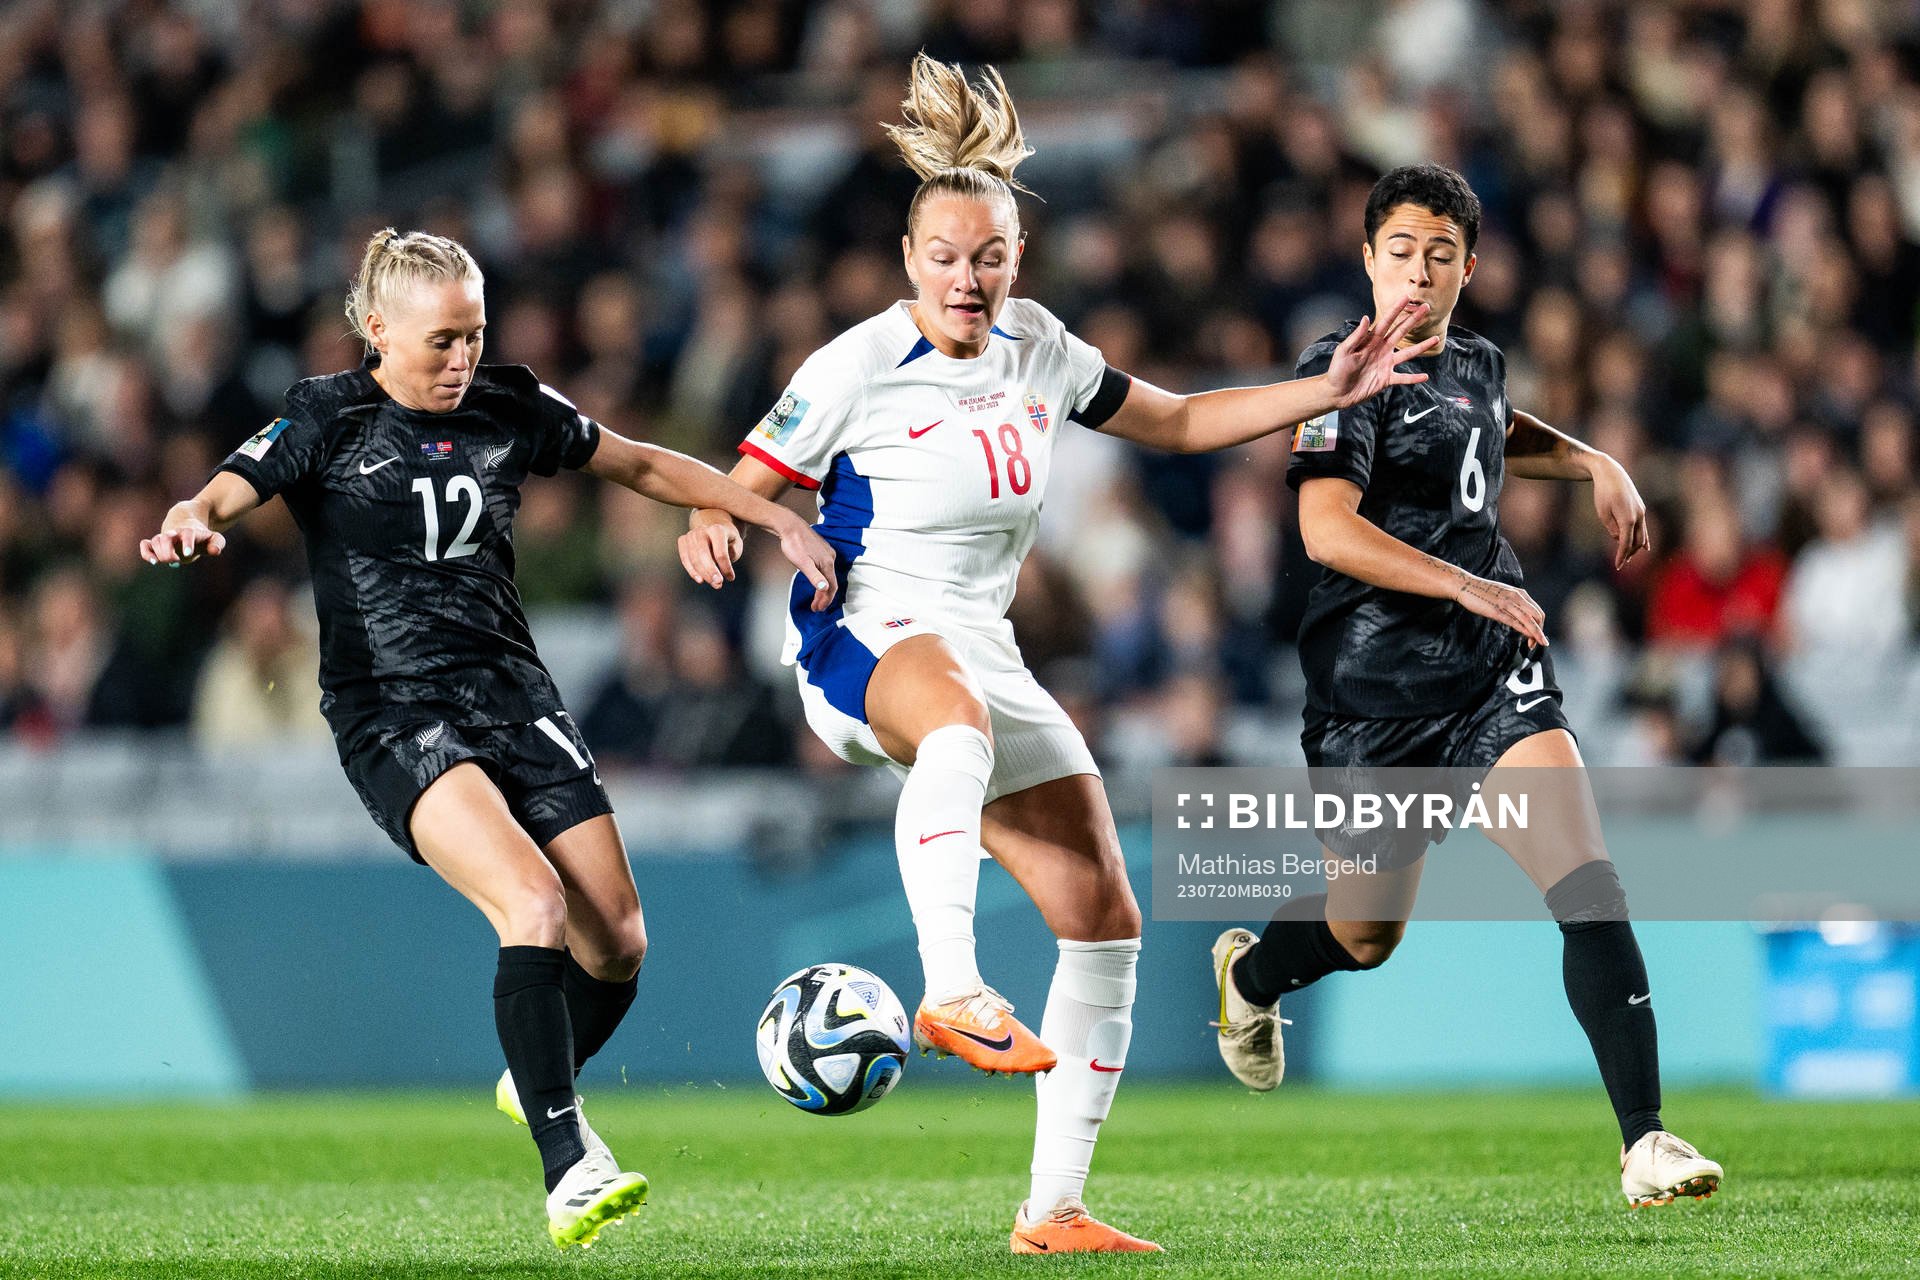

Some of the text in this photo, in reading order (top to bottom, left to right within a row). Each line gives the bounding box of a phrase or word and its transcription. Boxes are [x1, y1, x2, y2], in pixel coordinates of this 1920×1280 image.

[972, 423, 1031, 498] 18
[1460, 427, 1486, 513] 6
[411, 474, 483, 562] 12
